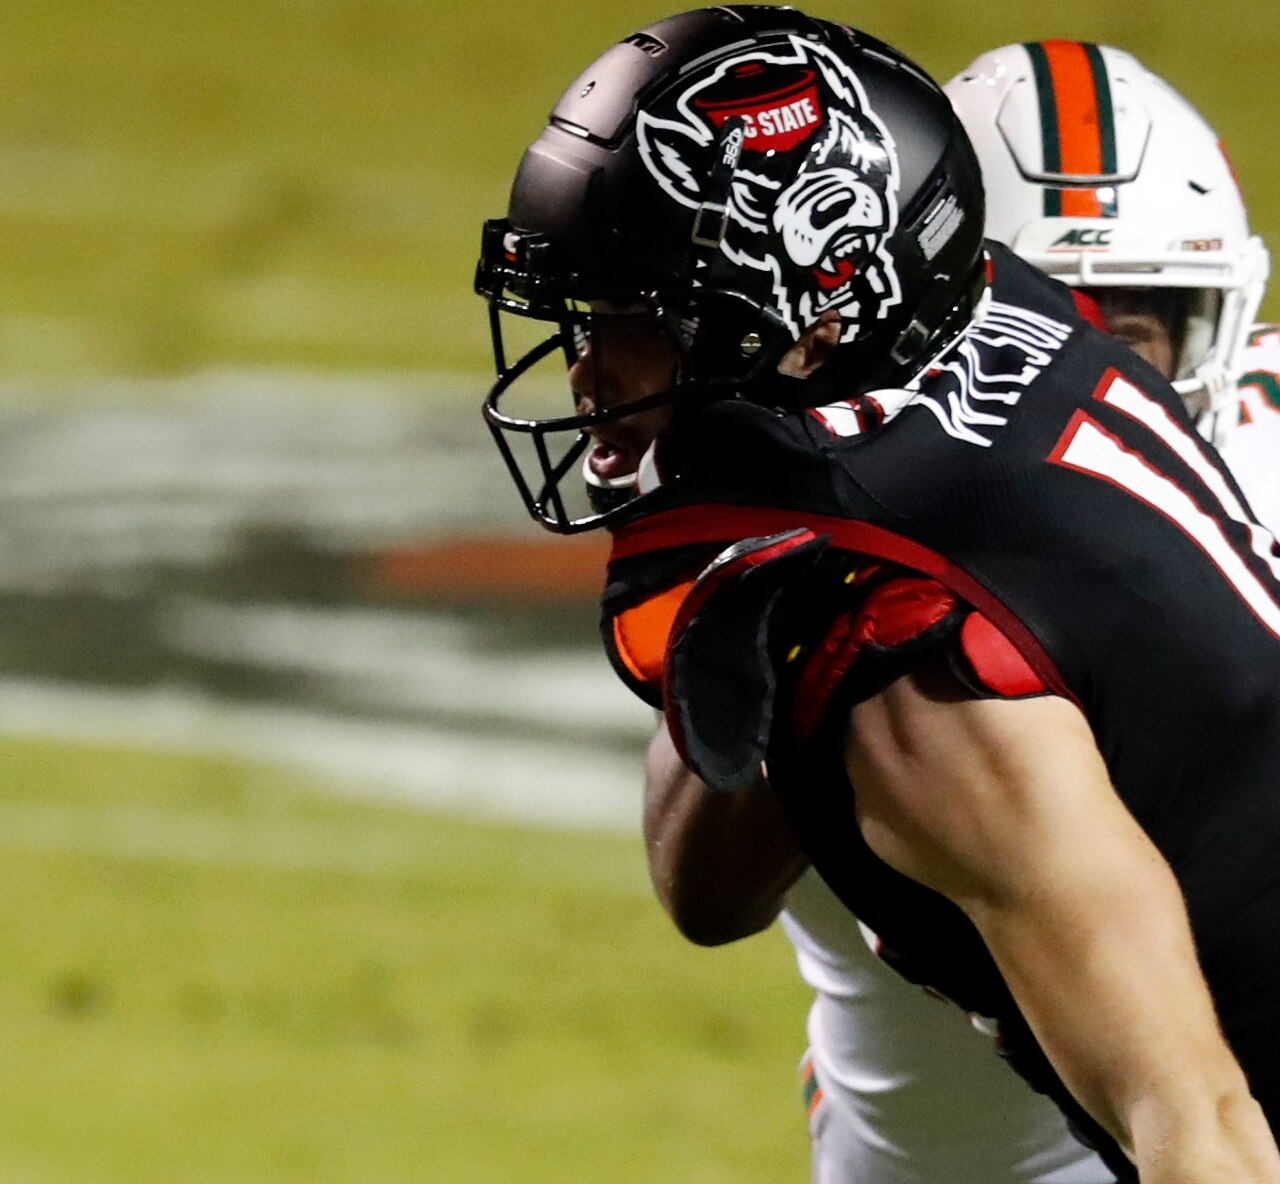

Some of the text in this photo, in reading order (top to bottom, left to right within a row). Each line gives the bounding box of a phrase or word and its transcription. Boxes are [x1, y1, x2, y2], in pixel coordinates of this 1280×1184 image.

[757, 98, 818, 136] STATE
[722, 128, 743, 168] 360
[1050, 229, 1114, 246] ACC
